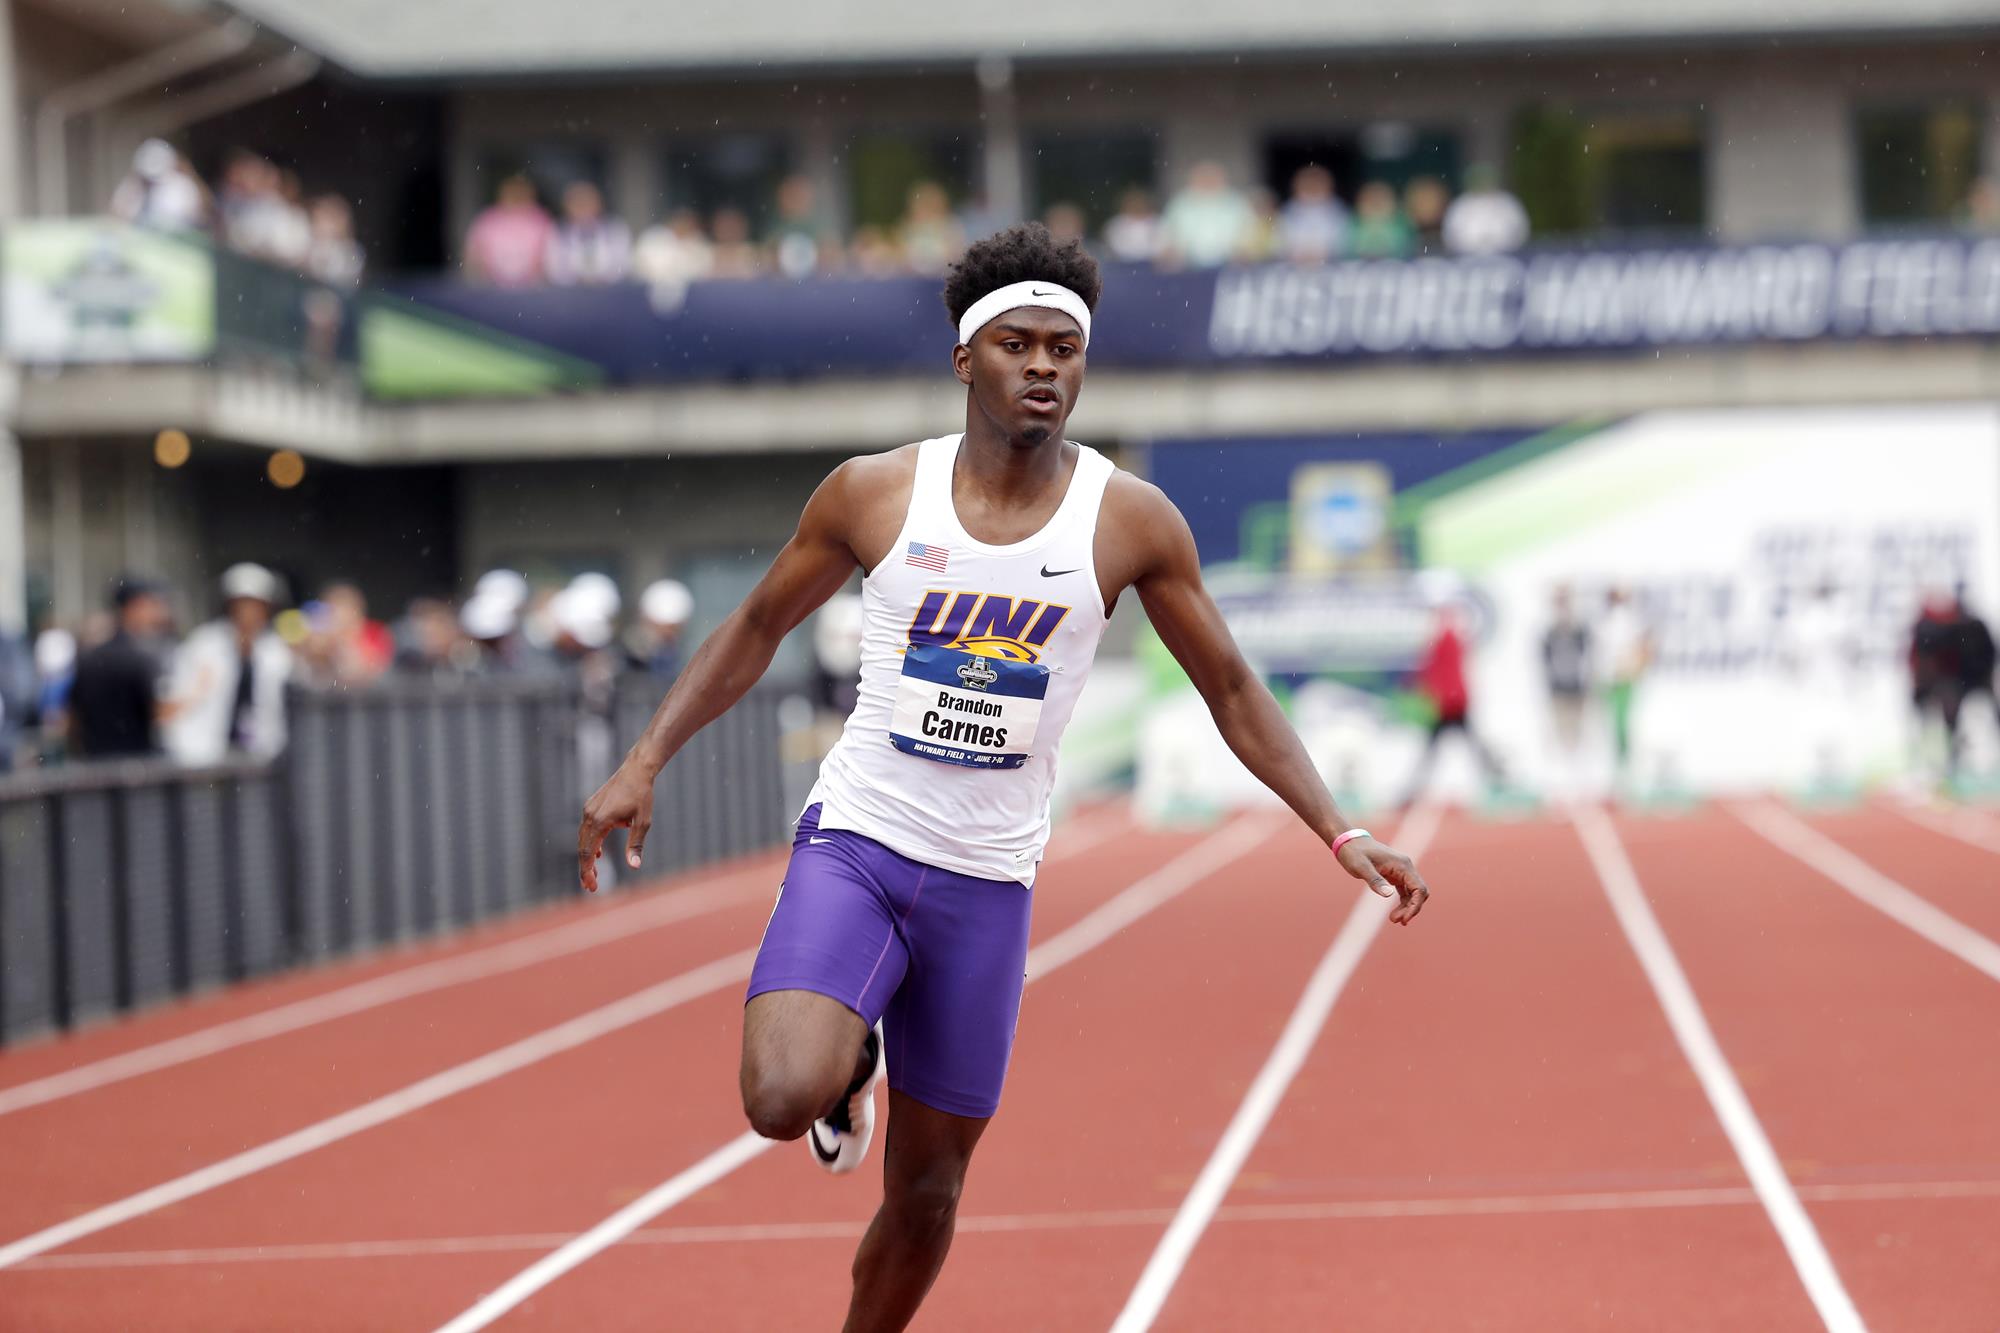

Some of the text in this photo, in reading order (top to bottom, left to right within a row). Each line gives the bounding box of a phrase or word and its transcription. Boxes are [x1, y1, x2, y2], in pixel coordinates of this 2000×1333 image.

[1209, 259, 1526, 354] HISTORIC
[1519, 245, 1833, 346] HAYWARD
[908, 590, 1069, 647] UNI
[937, 691, 1003, 718] Brandon
[921, 710, 1008, 748] Carnes
[914, 743, 946, 757] HAYWARD
[946, 750, 966, 760] FIELD
[974, 754, 991, 764] JUNE
